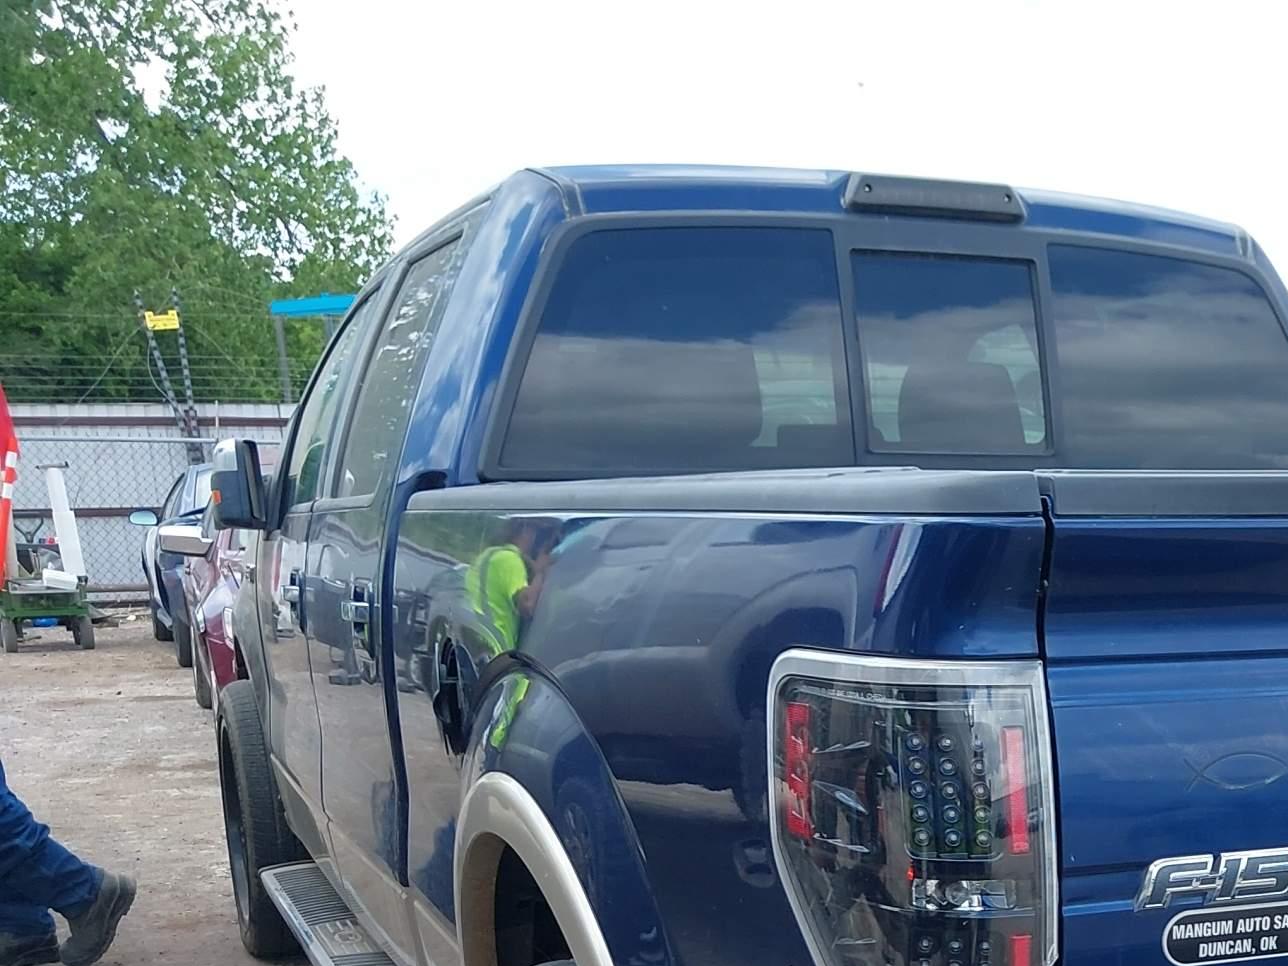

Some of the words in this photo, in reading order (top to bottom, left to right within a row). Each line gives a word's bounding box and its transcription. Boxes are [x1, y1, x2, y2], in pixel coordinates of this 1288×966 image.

[1172, 919, 1233, 940] MANGUM
[1236, 916, 1271, 934] AUTO
[1198, 939, 1256, 958] DUNCAN,
[1260, 935, 1278, 951] OK
